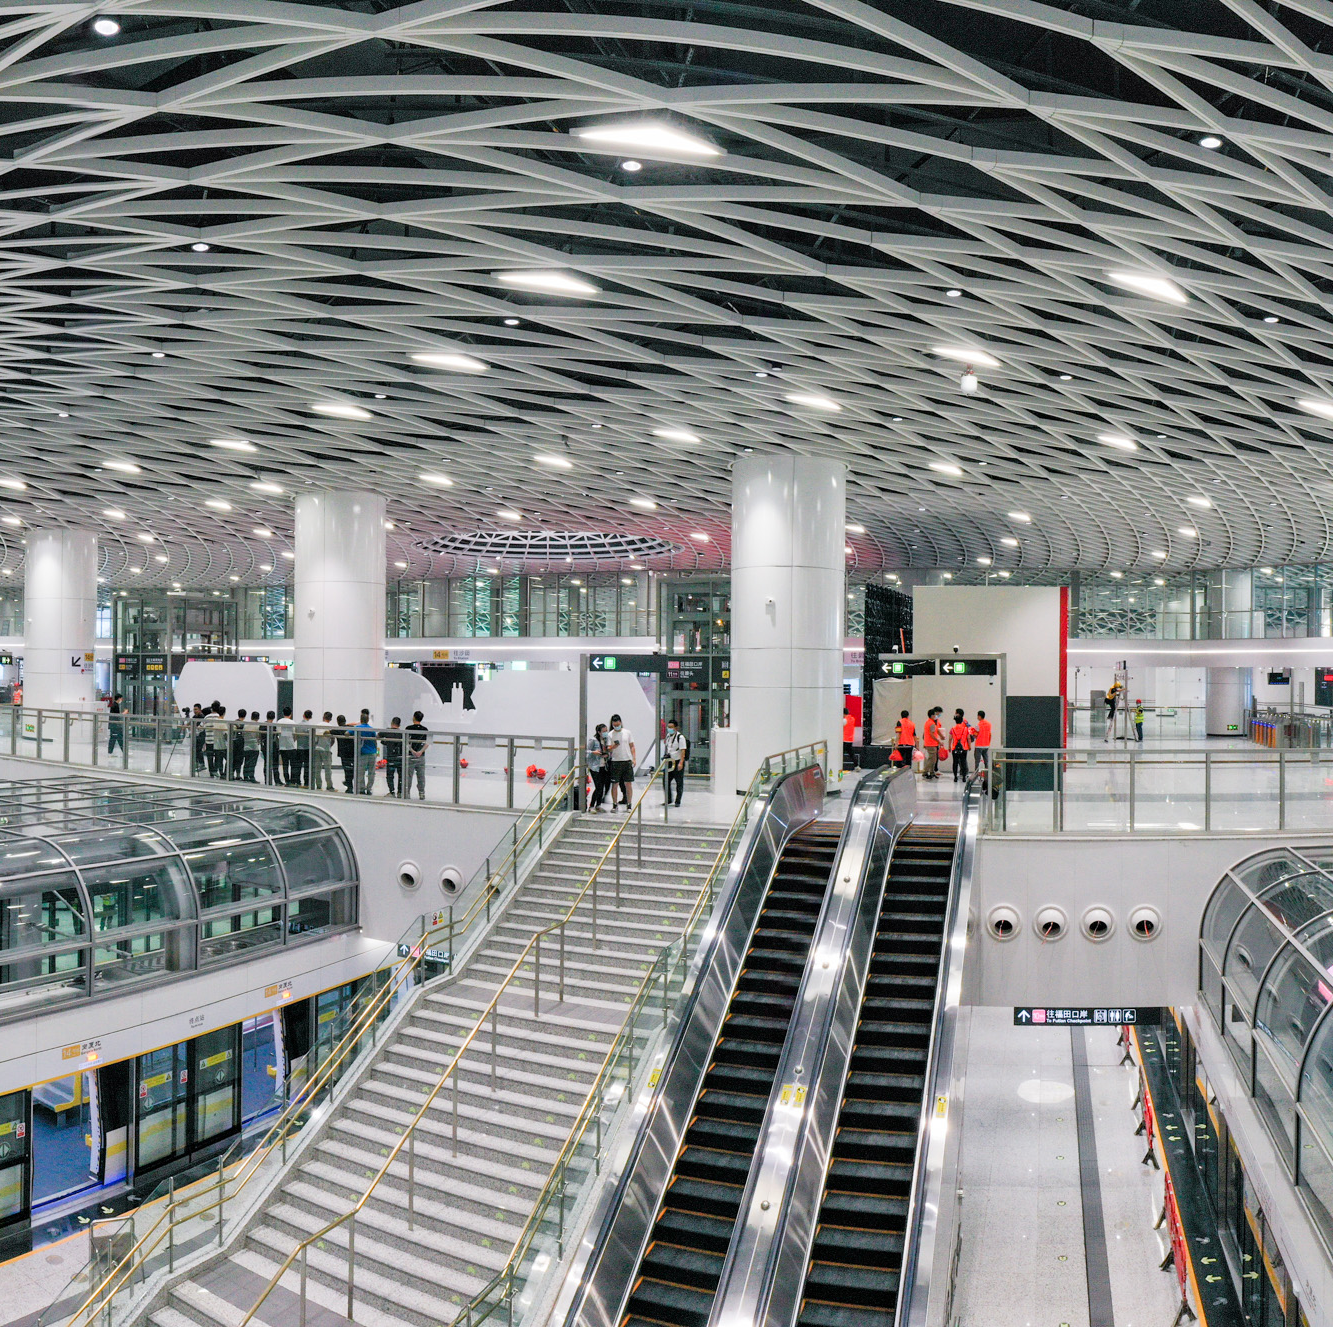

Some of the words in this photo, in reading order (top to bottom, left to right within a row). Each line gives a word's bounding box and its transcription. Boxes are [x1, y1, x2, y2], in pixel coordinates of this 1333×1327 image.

[1046, 1010, 1088, 1019] 往福田口岸
